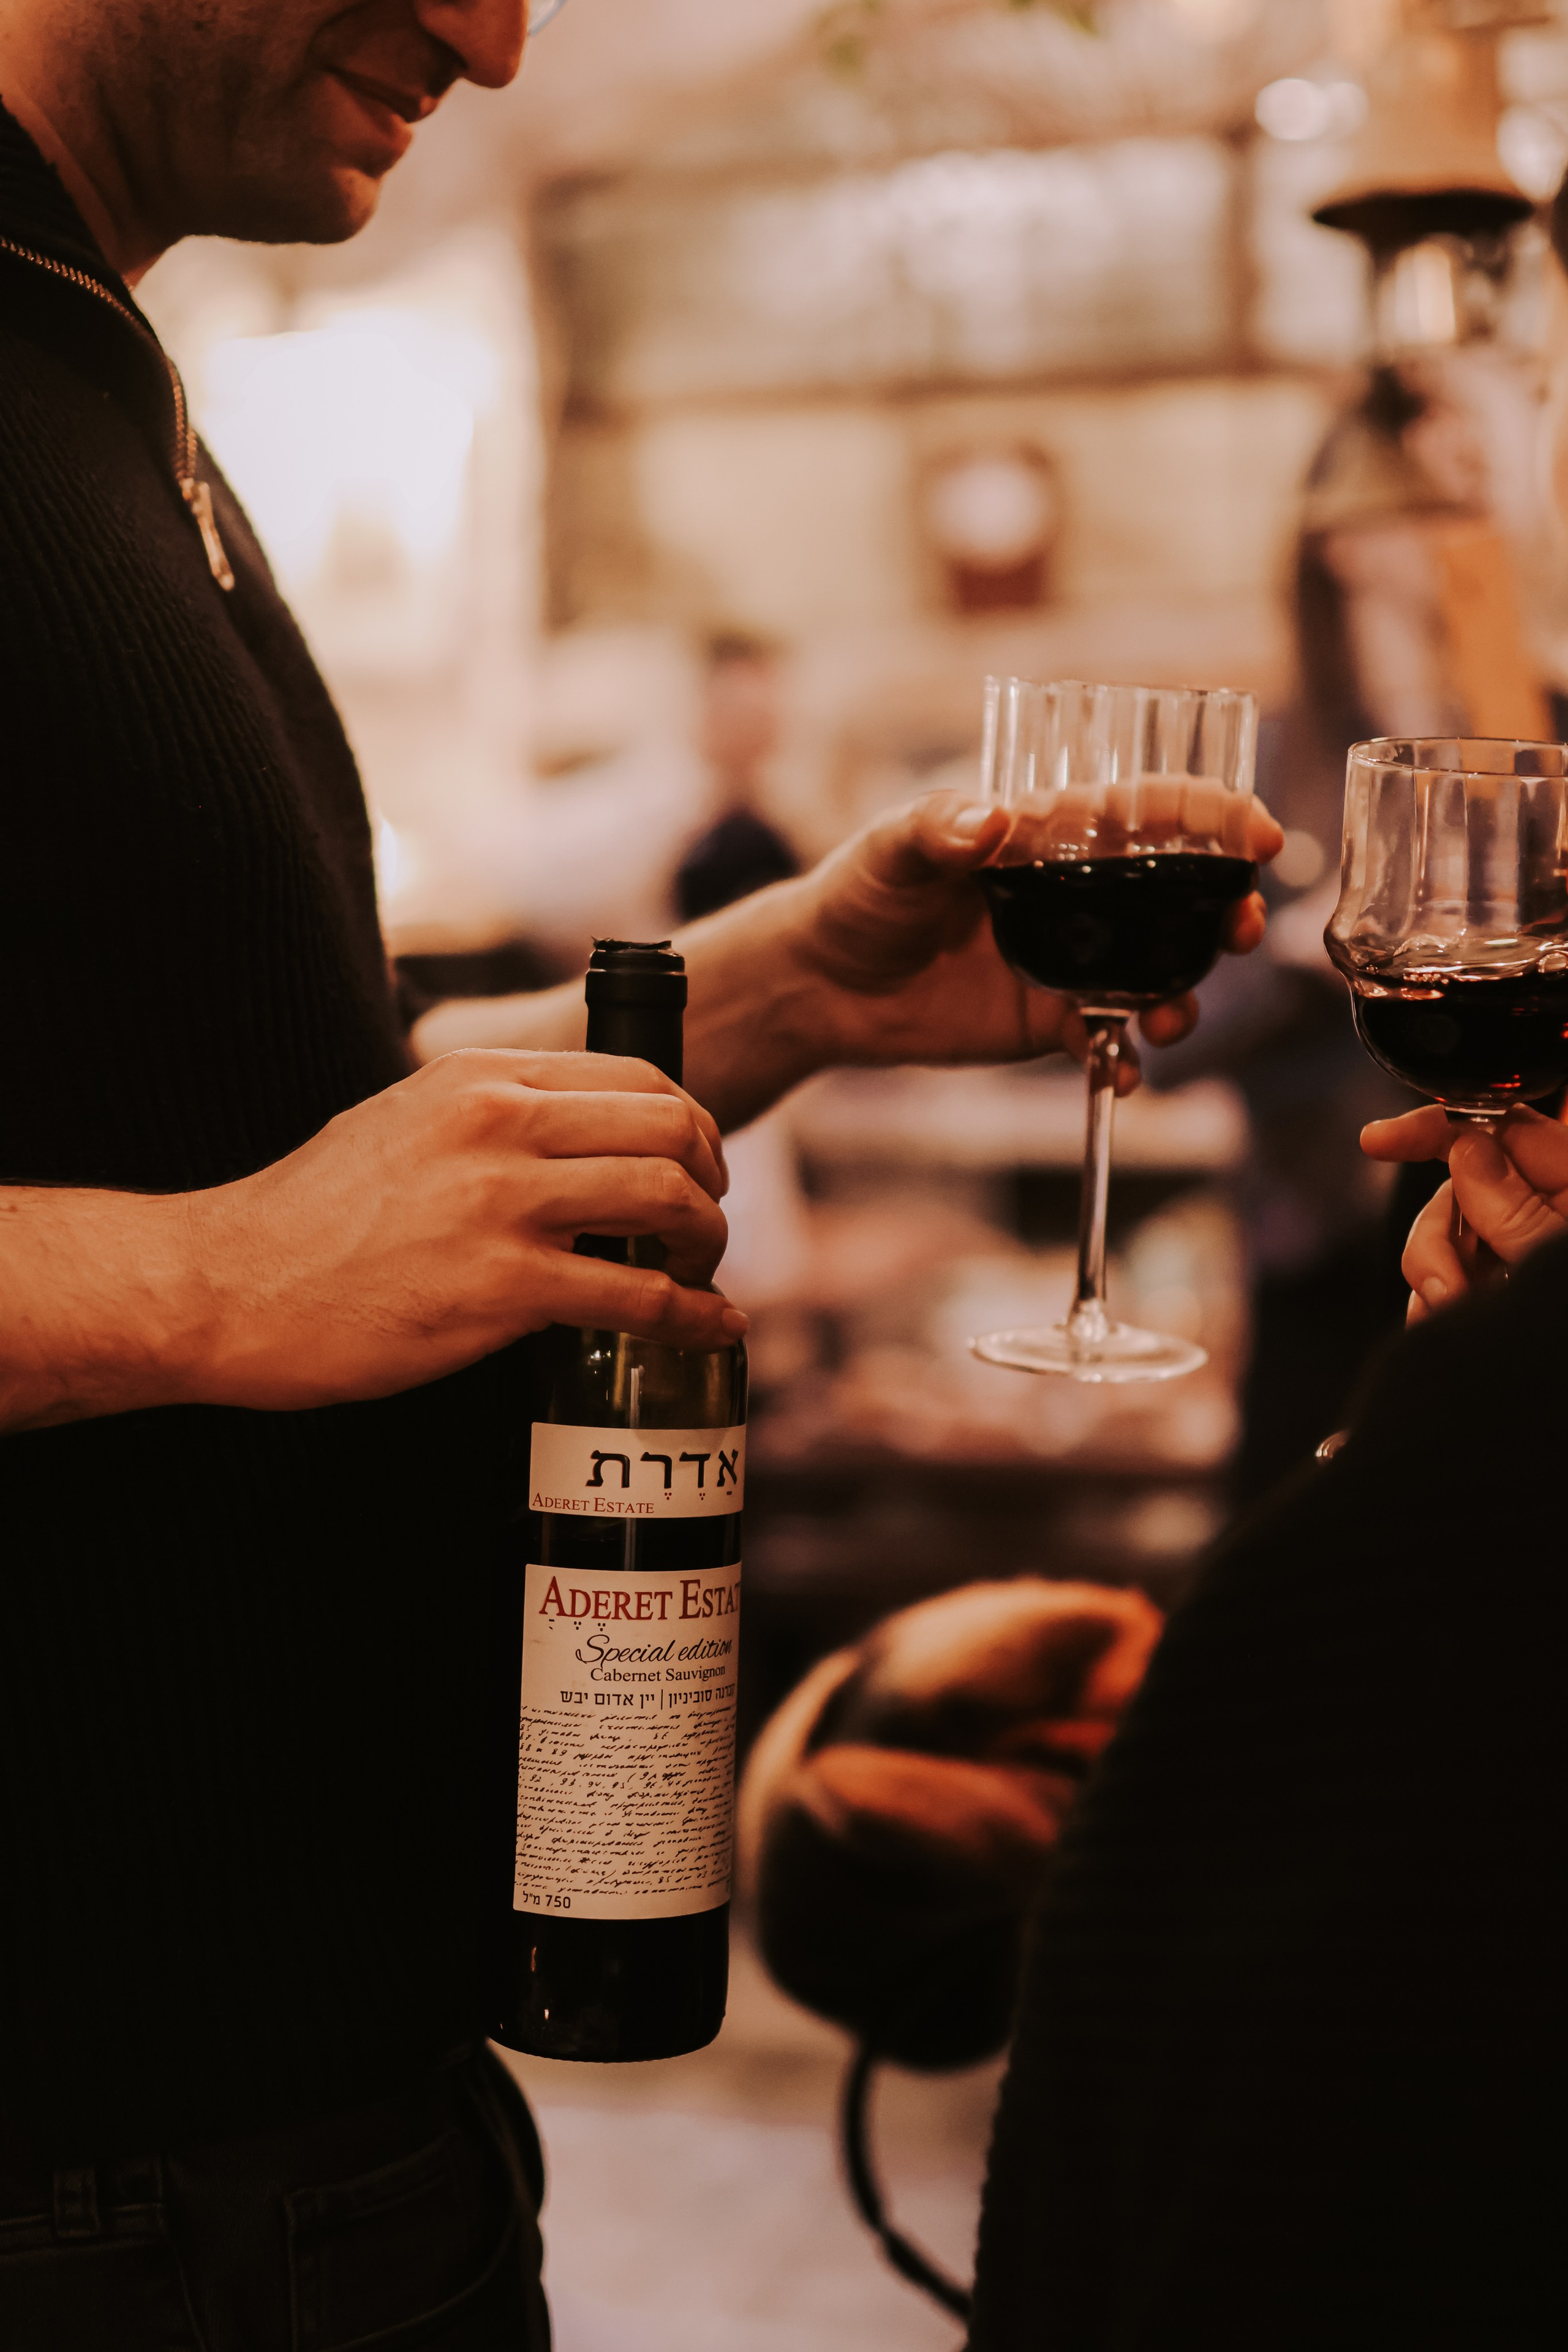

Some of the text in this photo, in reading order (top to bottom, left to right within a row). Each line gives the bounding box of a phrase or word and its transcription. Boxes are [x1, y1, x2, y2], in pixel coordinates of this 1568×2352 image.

[532, 1493, 654, 1513] ADERET ESTATE
[539, 1576, 673, 1620] ADERET
[575, 1634, 676, 1670] Special
[590, 1665, 726, 1682] Cabernet Sauvignon
[560, 1691, 588, 1704] יבש
[594, 1692, 634, 1706] אדום
[640, 1694, 655, 1709] יין
[668, 1689, 713, 1708] סוביניון
[545, 1894, 571, 1909] 750
